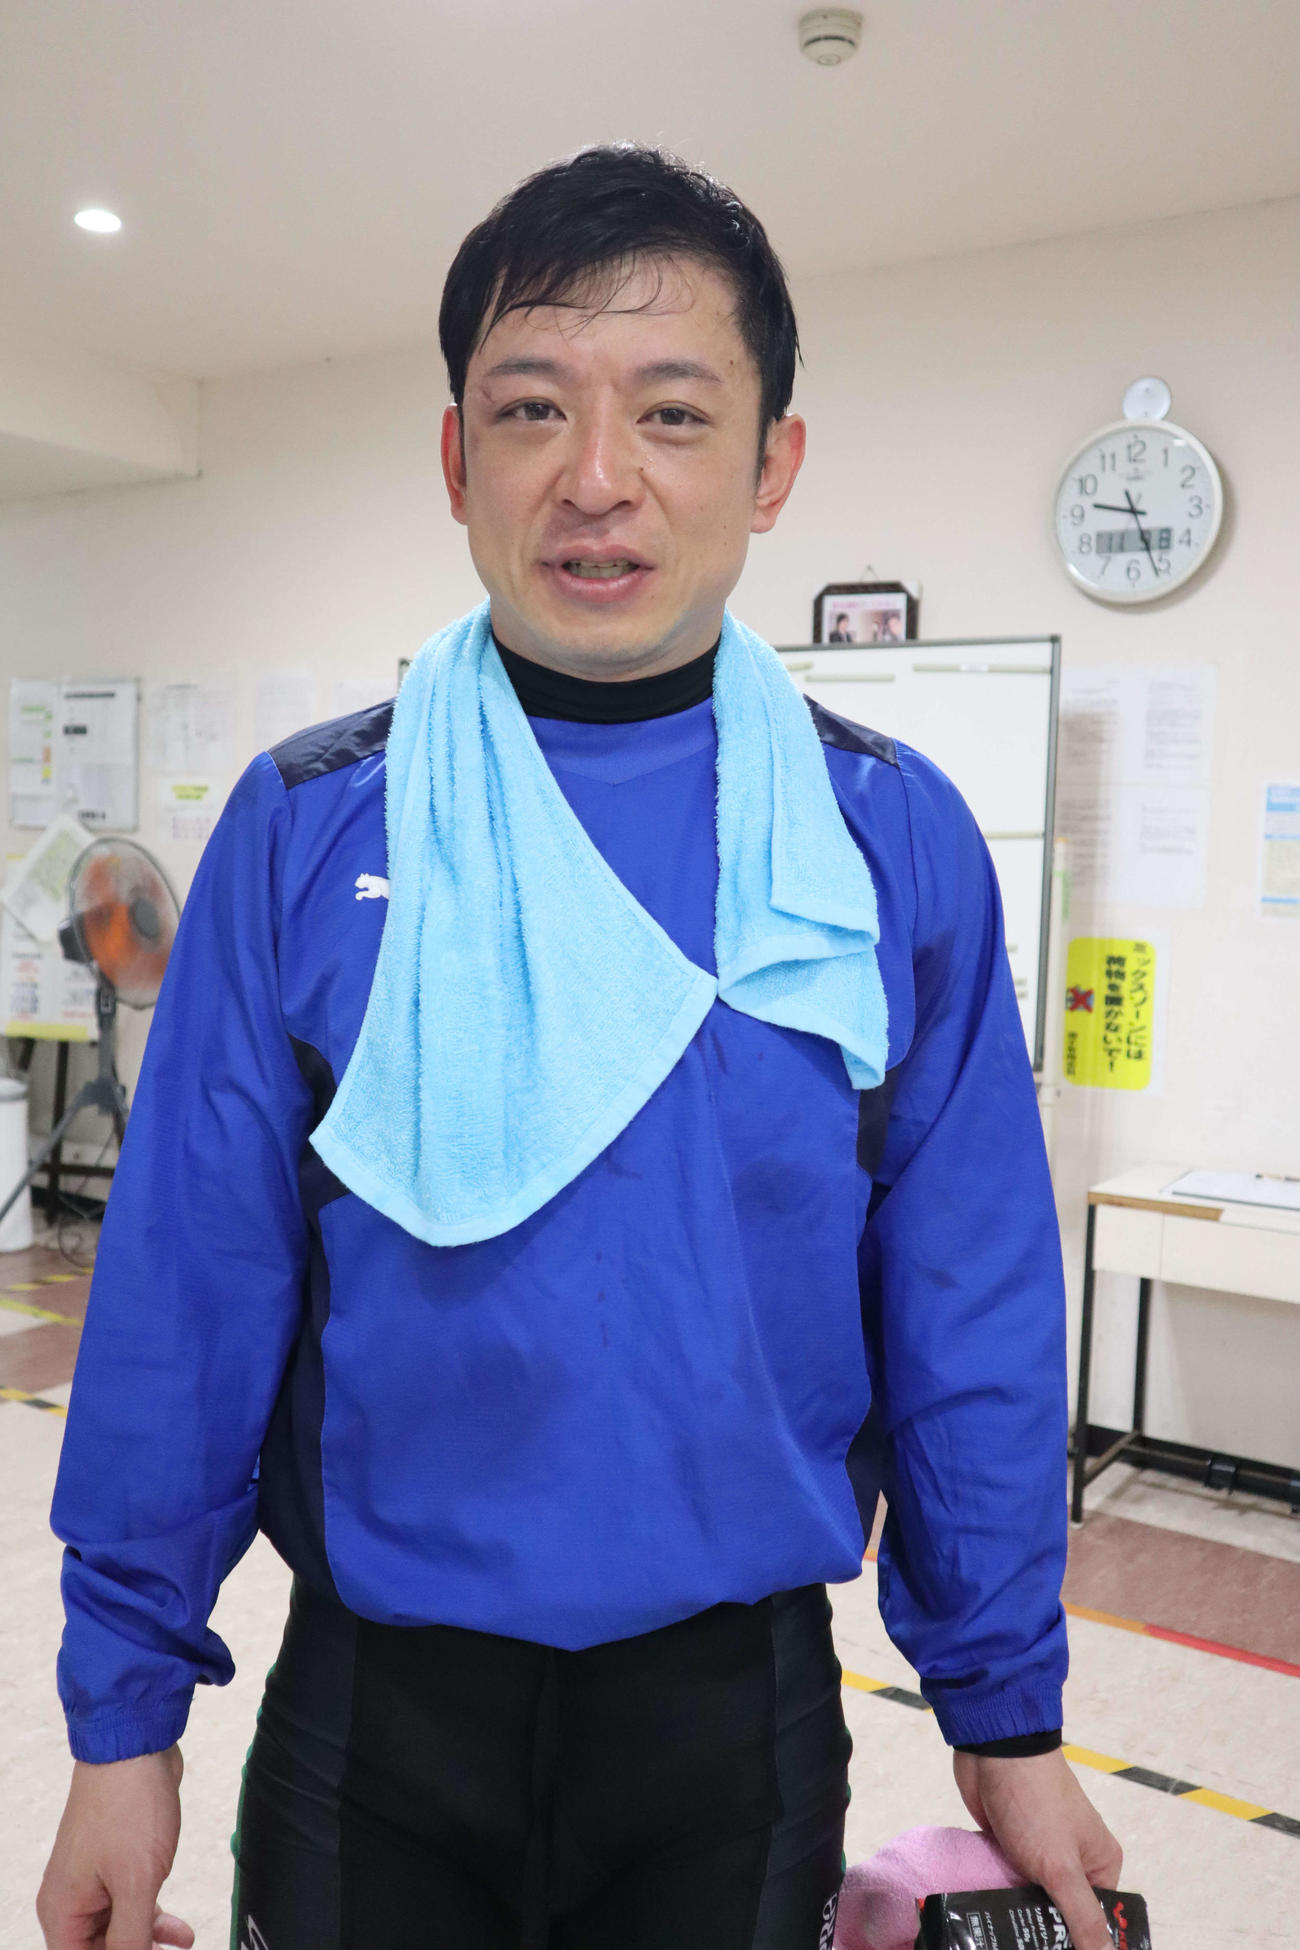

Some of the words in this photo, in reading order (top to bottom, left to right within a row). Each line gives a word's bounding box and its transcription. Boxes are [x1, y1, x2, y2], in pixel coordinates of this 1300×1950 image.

[1101, 452, 1116, 473] 11
[1127, 440, 1146, 464] 12
[1163, 448, 1169, 468] 1
[1079, 474, 1098, 496] 10
[1180, 465, 1196, 489] 2
[1070, 504, 1085, 526] 9
[1188, 495, 1203, 519] 3
[1079, 533, 1092, 554] 8
[1178, 528, 1192, 549] 4
[1099, 555, 1112, 576] 7
[1126, 560, 1140, 581] 6
[1159, 552, 1171, 574] 5
